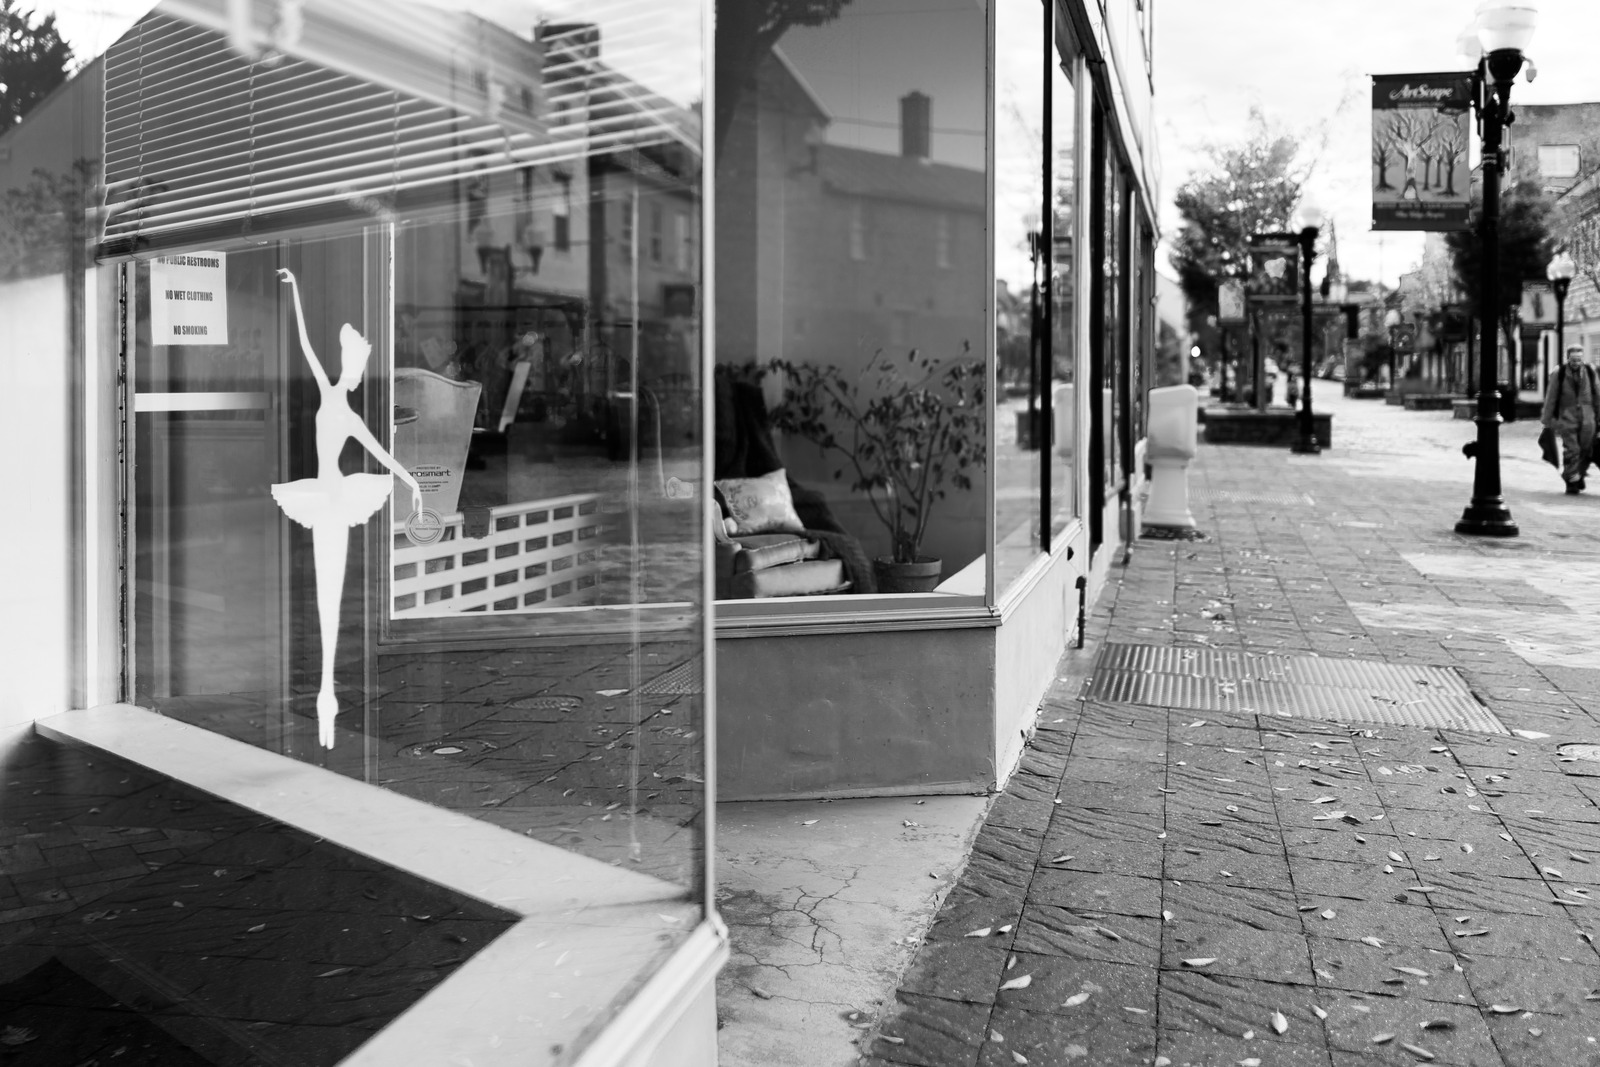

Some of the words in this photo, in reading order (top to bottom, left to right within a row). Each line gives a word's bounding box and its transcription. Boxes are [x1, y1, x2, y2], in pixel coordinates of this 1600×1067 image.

[1389, 84, 1453, 101] ArtScape
[166, 255, 186, 266] PUBLIC
[187, 257, 219, 268] RESTROOMS
[165, 290, 173, 300] NO
[174, 290, 186, 301] WET
[186, 291, 213, 301] CLOTHING
[173, 325, 181, 335] NO
[182, 325, 207, 335] SMOKING
